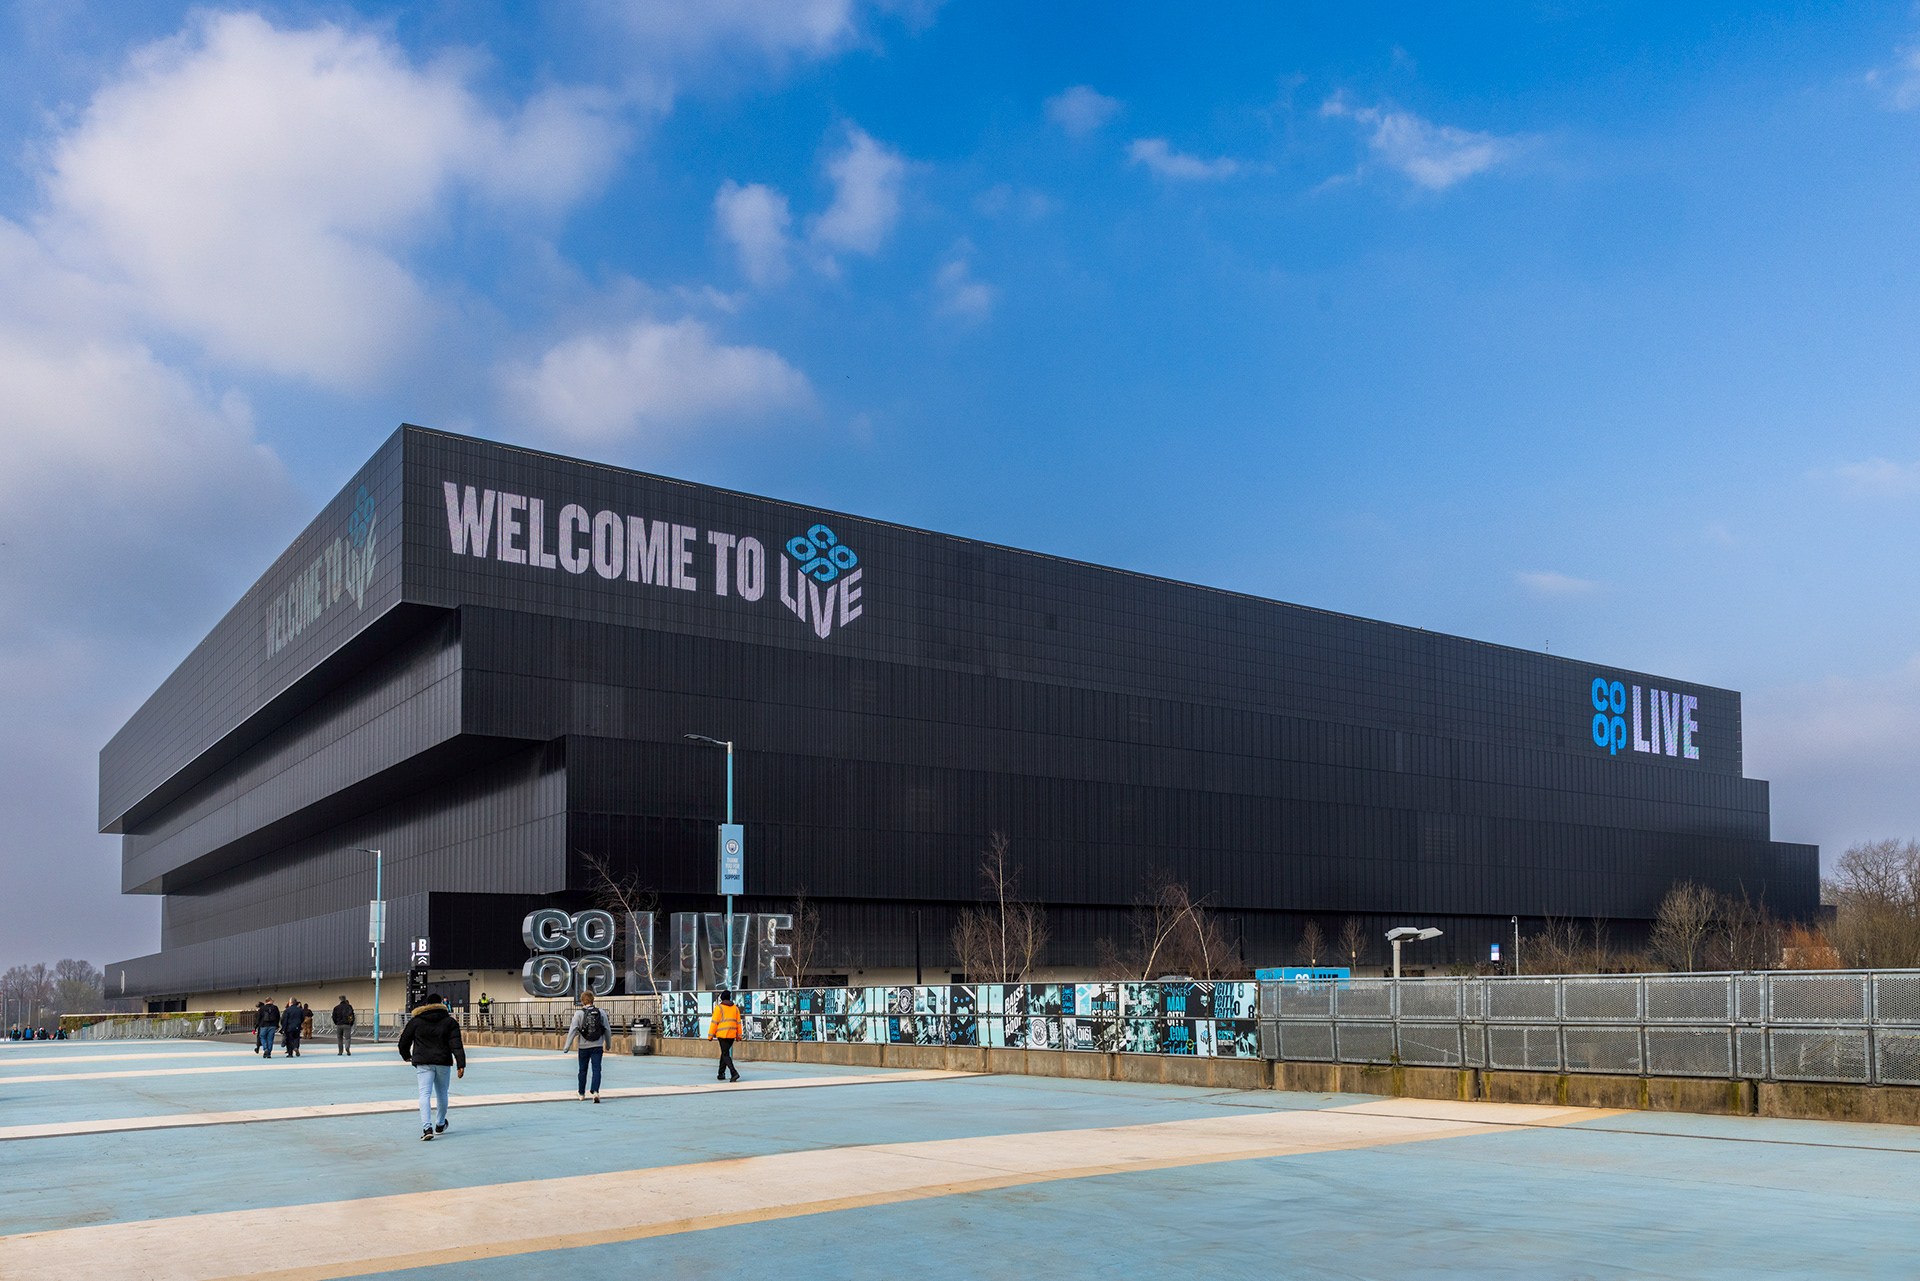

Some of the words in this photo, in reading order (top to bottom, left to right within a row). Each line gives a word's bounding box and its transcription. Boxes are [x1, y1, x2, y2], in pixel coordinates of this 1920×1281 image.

[443, 481, 697, 591] WELCOME
[708, 530, 765, 602] TO
[346, 513, 377, 611] LIVE
[266, 555, 323, 661] WELCOME
[325, 537, 342, 610] TO
[780, 552, 863, 640] LIVE
[1632, 684, 1700, 760] LIVE
[418, 939, 427, 952] B
[625, 910, 794, 995] LIVE
[1004, 984, 1025, 1013] RAISE
[1105, 991, 1117, 1002] TH
[1238, 982, 1245, 998] 8
[1091, 1002, 1117, 1010] ULTMAT
[1166, 996, 1186, 1011] MAN
[1167, 1011, 1185, 1026] CITY
[1217, 1030, 1234, 1040] CCTV
